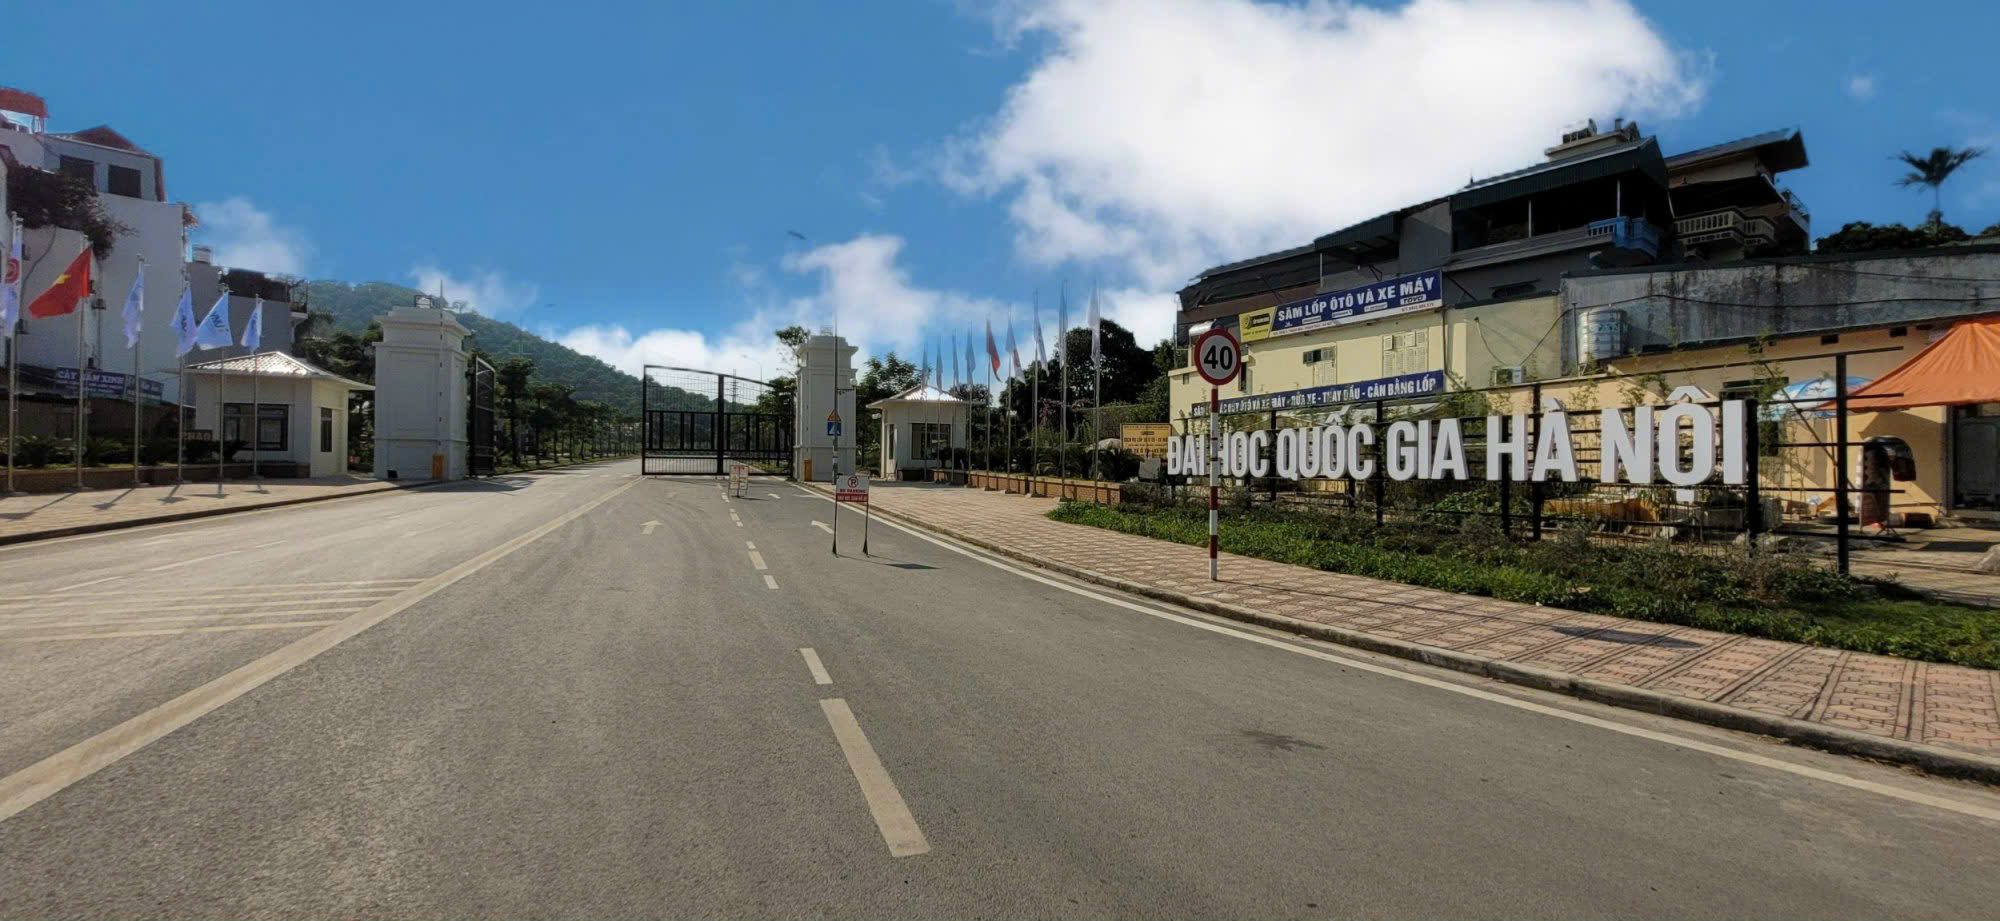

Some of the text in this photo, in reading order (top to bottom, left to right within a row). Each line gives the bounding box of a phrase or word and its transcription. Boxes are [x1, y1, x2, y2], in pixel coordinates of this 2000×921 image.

[1305, 298, 1327, 317] LỐP
[1330, 293, 1354, 312] ÔTÔ
[1357, 288, 1374, 305] VÀ
[1378, 285, 1396, 301] XE
[1400, 276, 1435, 296] MÁY
[1203, 344, 1233, 371] 40
[1306, 392, 1317, 404] XE
[1367, 382, 1387, 399] CÂN
[1276, 405, 1375, 481] QUỐC
[1386, 418, 1469, 481] GIA
[1486, 397, 1580, 482] HÀ
[1600, 385, 1748, 502] NỘI
